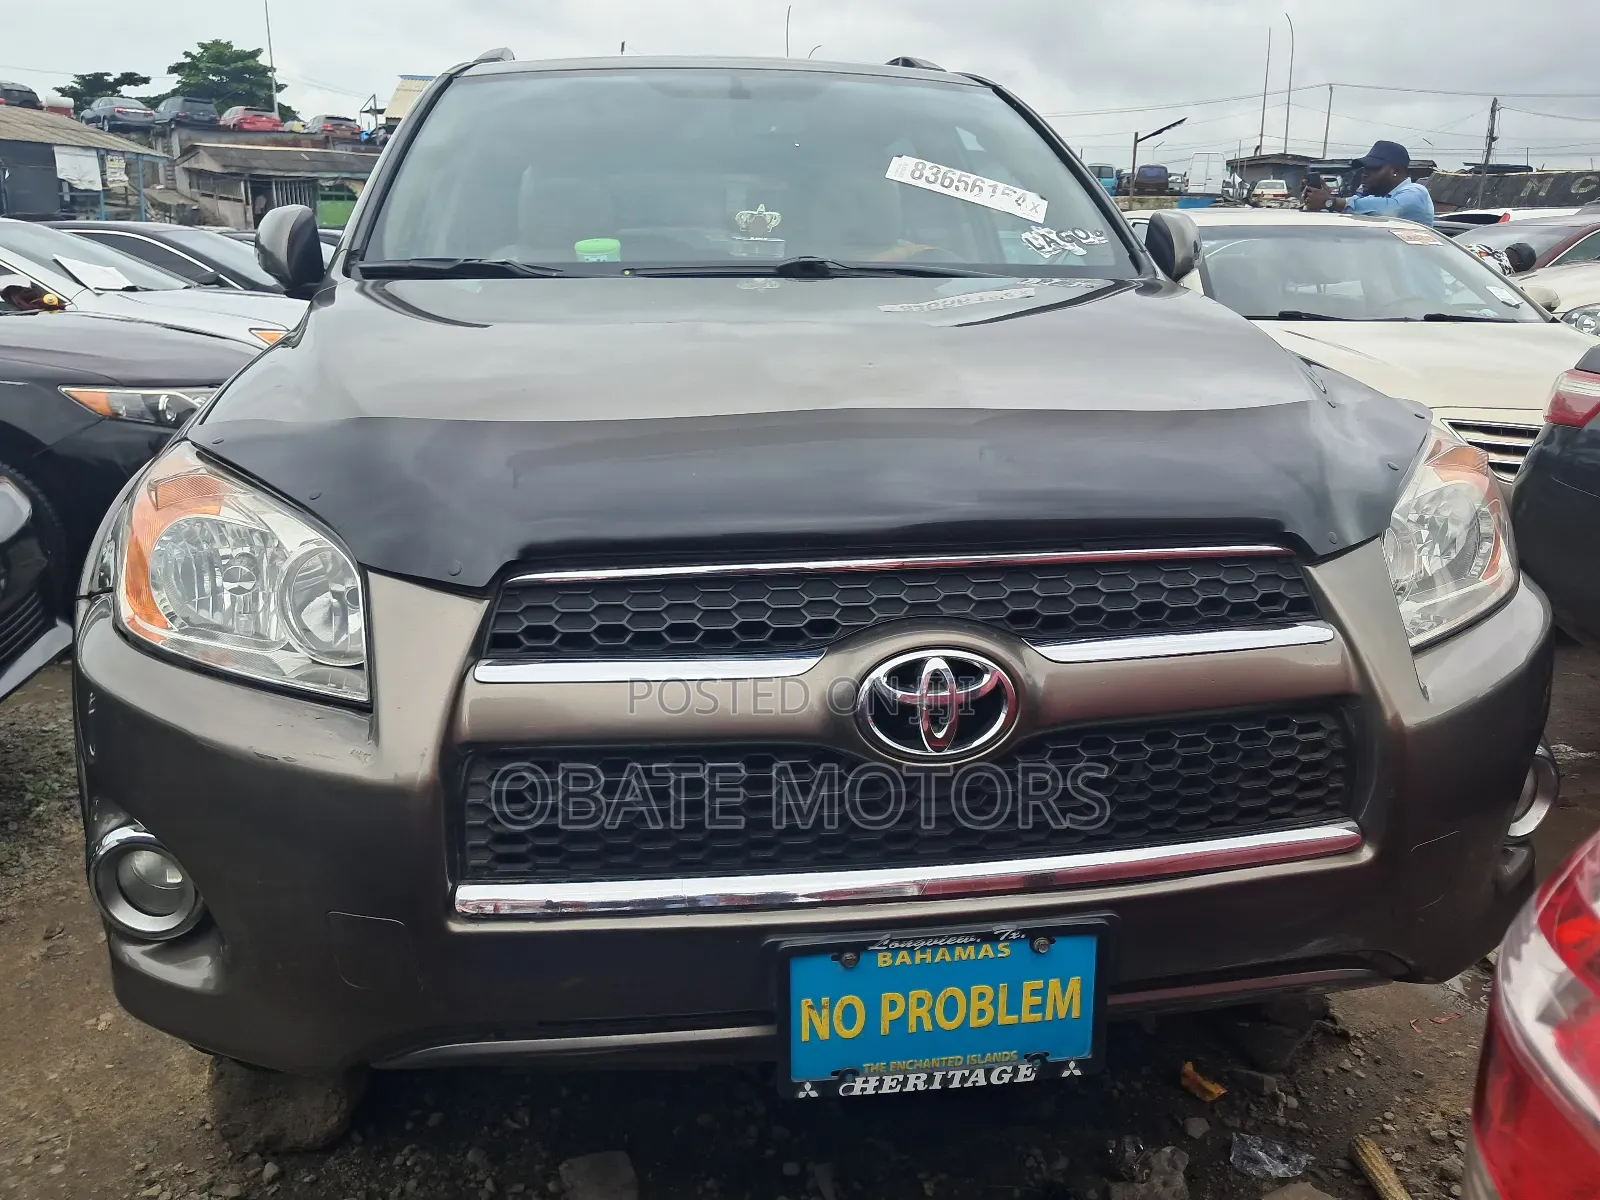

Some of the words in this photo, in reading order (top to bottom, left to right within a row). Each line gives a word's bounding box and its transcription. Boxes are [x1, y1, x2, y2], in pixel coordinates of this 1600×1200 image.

[1024, 227, 1104, 251] LAGO
[877, 942, 1011, 967] BAHAMAS
[801, 995, 866, 1042] NO
[880, 976, 1082, 1036] PROBLEM
[863, 1063, 887, 1074] THE
[889, 1056, 964, 1072] ENCHANTED
[966, 1051, 1018, 1065] ISLANDS
[838, 1064, 1038, 1097] HERITAGE
